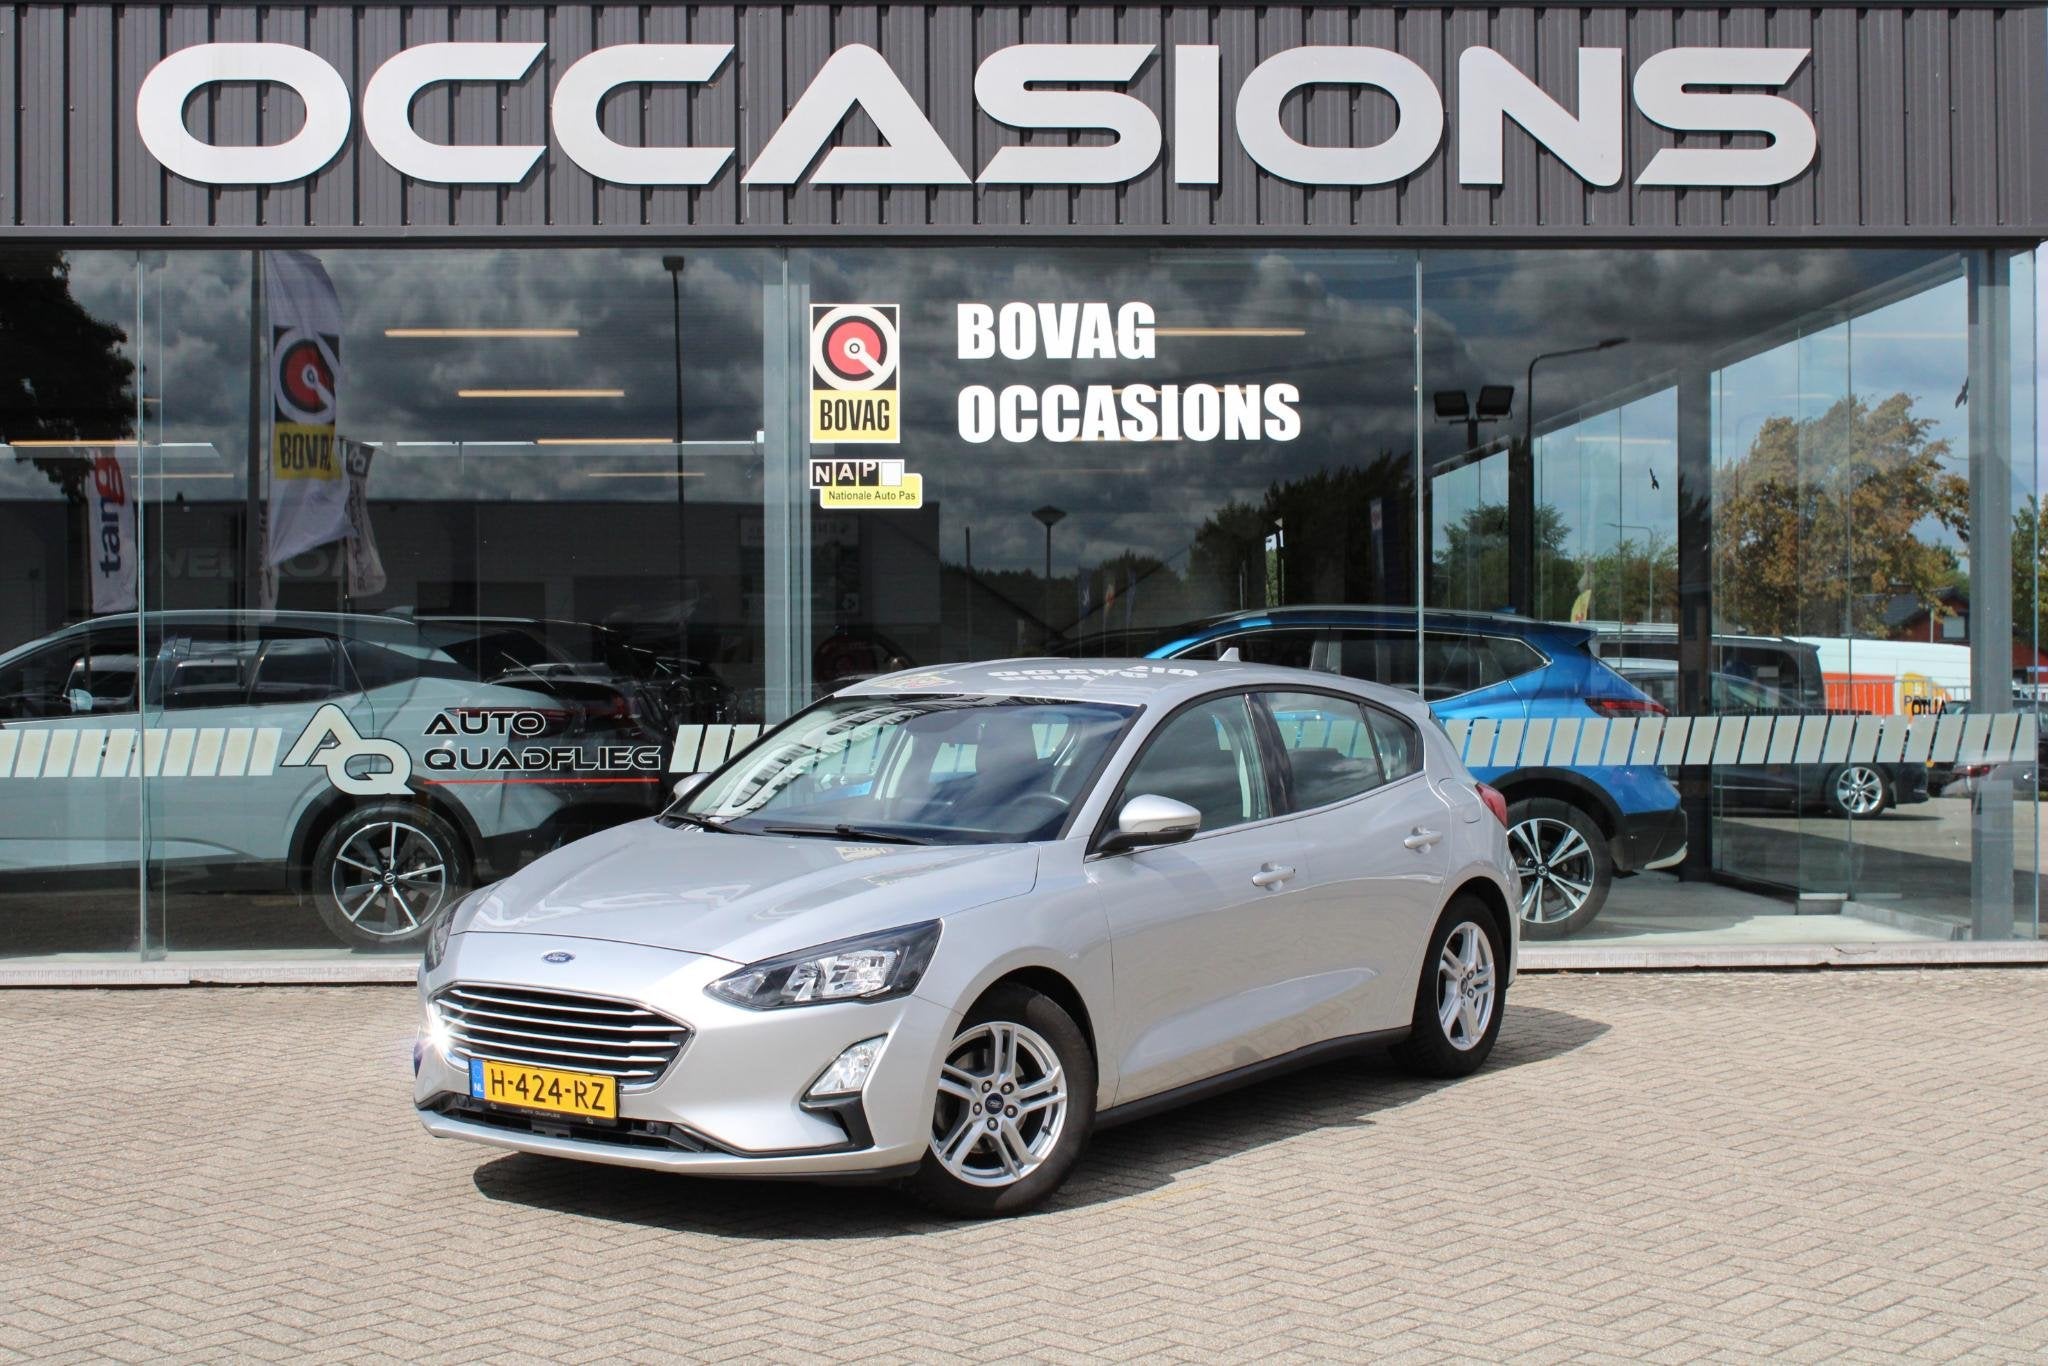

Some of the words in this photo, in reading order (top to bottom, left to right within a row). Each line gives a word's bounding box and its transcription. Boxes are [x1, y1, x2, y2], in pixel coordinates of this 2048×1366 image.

[136, 42, 1817, 187] OCCASIONS
[957, 301, 1157, 360] BOVAG
[819, 398, 891, 432] BOVAG
[957, 383, 1302, 444] OCCASIONS
[815, 461, 878, 483] NAP
[828, 490, 872, 500] Nationale
[874, 490, 897, 500] Auto
[898, 490, 916, 500] Pas
[423, 711, 547, 736] AUTO
[423, 745, 662, 772] QUADFLIEG
[474, 1082, 483, 1092] NL
[490, 1067, 606, 1112] H-424-RZ
